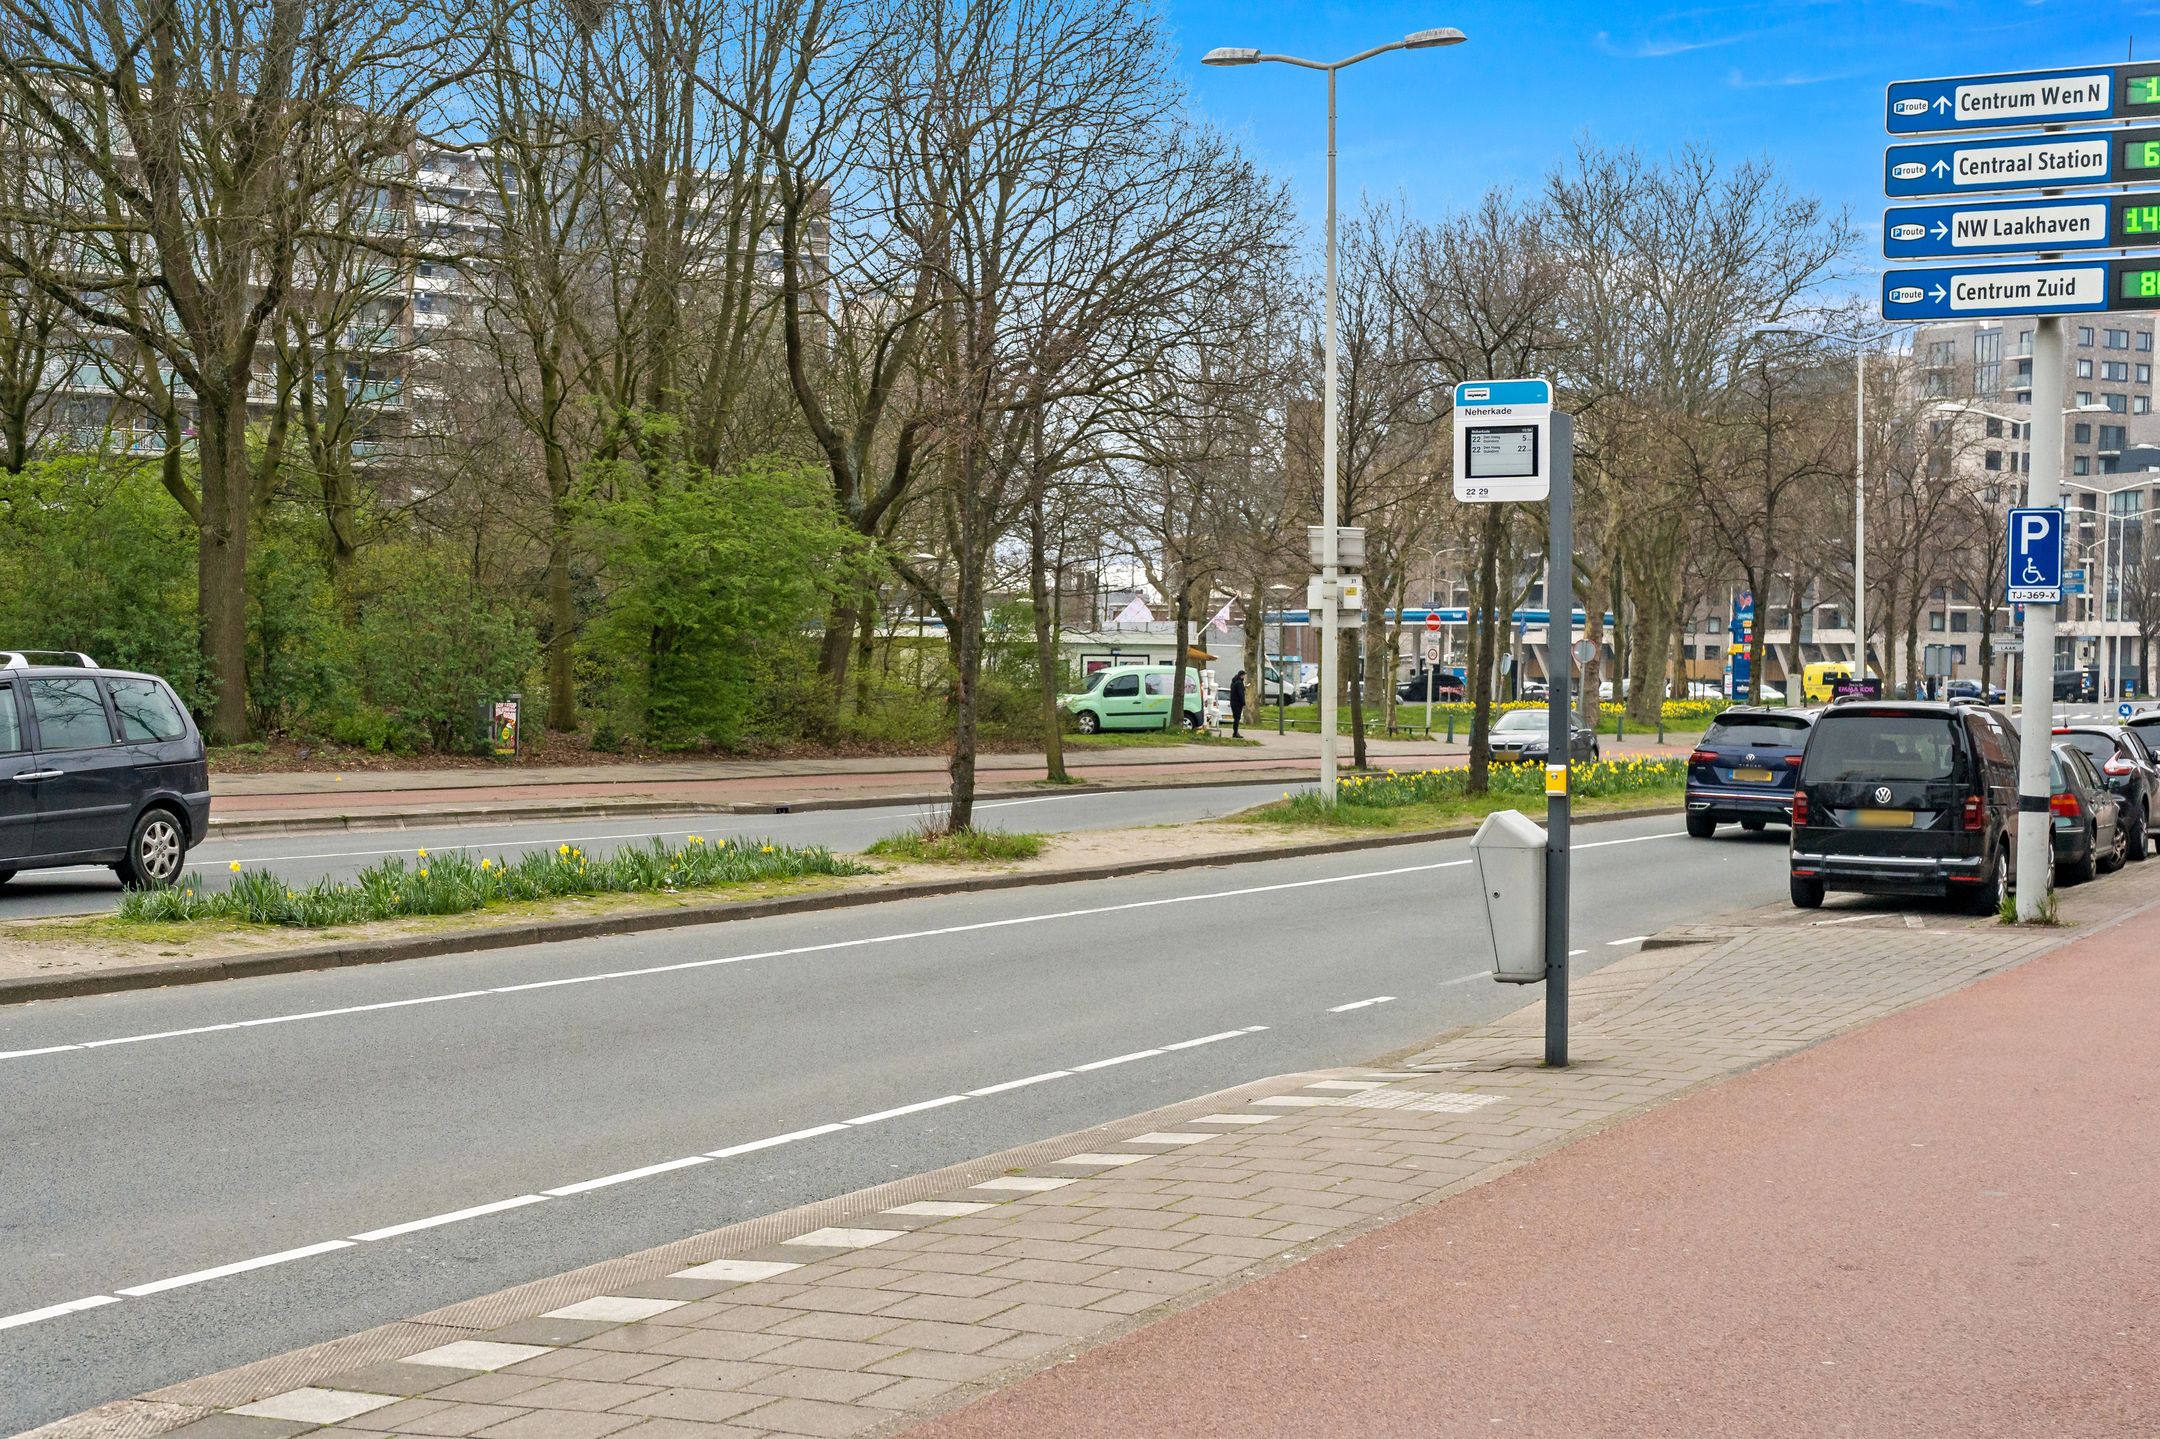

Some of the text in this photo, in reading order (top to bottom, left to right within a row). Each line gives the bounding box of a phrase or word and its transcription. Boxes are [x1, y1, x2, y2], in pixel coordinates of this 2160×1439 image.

[1961, 92, 2035, 111] Centrum
[2088, 83, 2100, 102] N
[1905, 103, 1927, 111] route
[1959, 149, 2102, 176] Centraal Station
[1902, 166, 1924, 174] route
[2126, 207, 2160, 232] 14
[1902, 226, 1924, 235] route
[1957, 216, 2090, 238] NW Laakhaven
[1956, 277, 2076, 301] Centrum Zuid
[1901, 290, 1922, 298] route
[1464, 407, 1512, 416] Neherkade
[1478, 487, 1489, 495] 29
[2021, 515, 2050, 555] P
[2012, 591, 2056, 600] TJ-369-X
